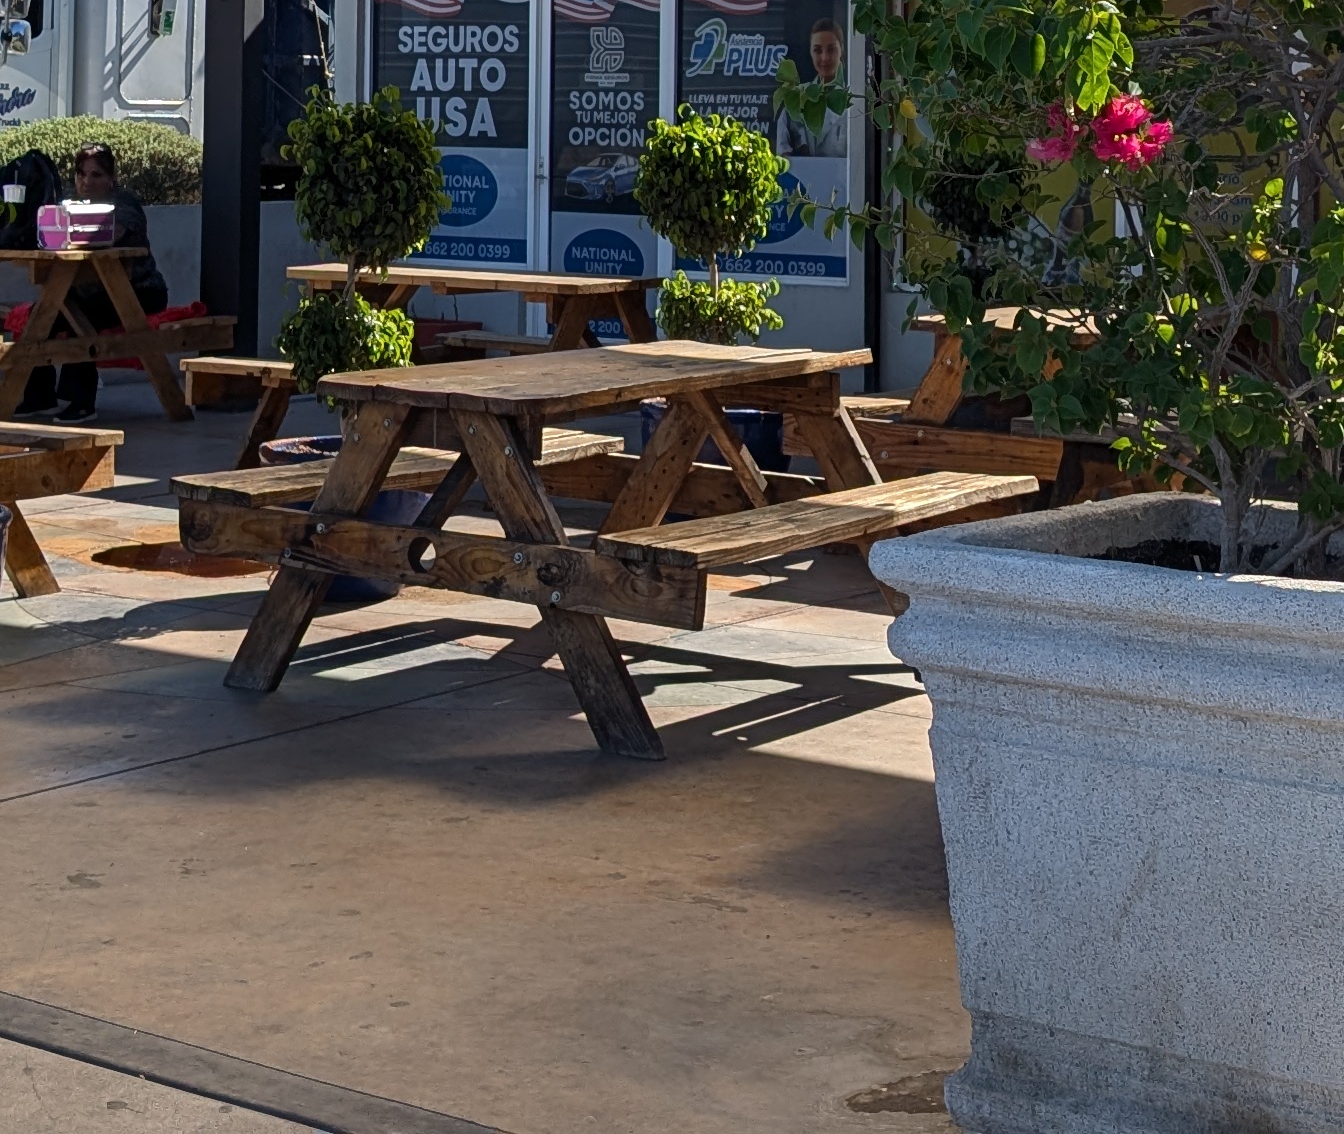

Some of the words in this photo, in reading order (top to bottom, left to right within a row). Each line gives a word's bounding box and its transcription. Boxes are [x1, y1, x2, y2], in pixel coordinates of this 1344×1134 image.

[398, 25, 519, 53] SEGUROS
[725, 46, 786, 74] PLUS
[410, 58, 506, 92] AUTO
[569, 91, 644, 110] SOMOS
[688, 95, 715, 104] LLEVA
[716, 95, 729, 104] EN
[730, 95, 741, 104] TU
[742, 95, 768, 104] VIAJE
[416, 97, 497, 137] USA
[575, 111, 590, 123] TU
[594, 112, 636, 124] MEJOR
[699, 106, 712, 117] LA
[717, 106, 759, 118] MEJOR
[568, 124, 644, 146] OPCIÓN
[442, 175, 489, 188] TIONAL
[425, 242, 447, 256] 662
[451, 243, 474, 257] 200
[478, 244, 510, 258] 0399
[572, 247, 635, 262] NATIONAL
[585, 261, 622, 274] UNITY
[725, 259, 752, 272] 662
[756, 260, 783, 274] 200
[788, 261, 825, 275] 0399
